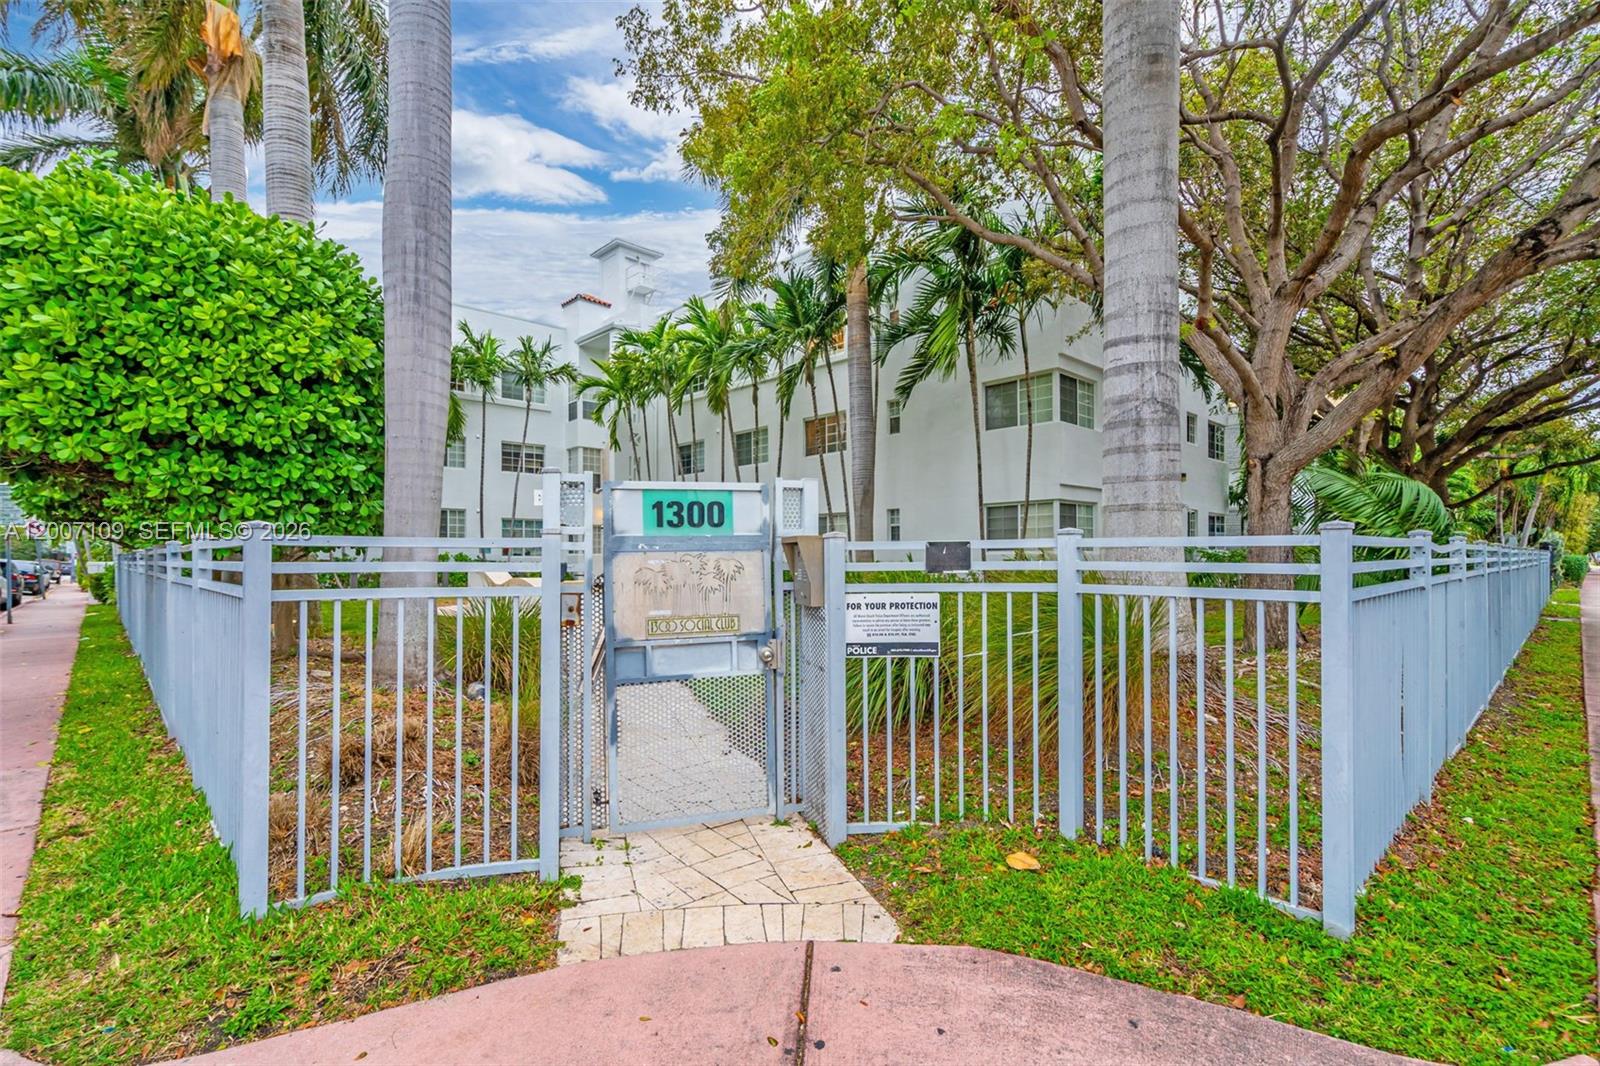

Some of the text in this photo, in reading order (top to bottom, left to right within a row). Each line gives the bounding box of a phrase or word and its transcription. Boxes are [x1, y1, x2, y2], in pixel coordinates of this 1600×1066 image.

[651, 500, 725, 529] 1300
[846, 601, 938, 611] FOR YOUR PROTECTION
[679, 619, 714, 632] SOCIAL
[715, 617, 737, 631] CLUB
[847, 646, 878, 655] POLICE
